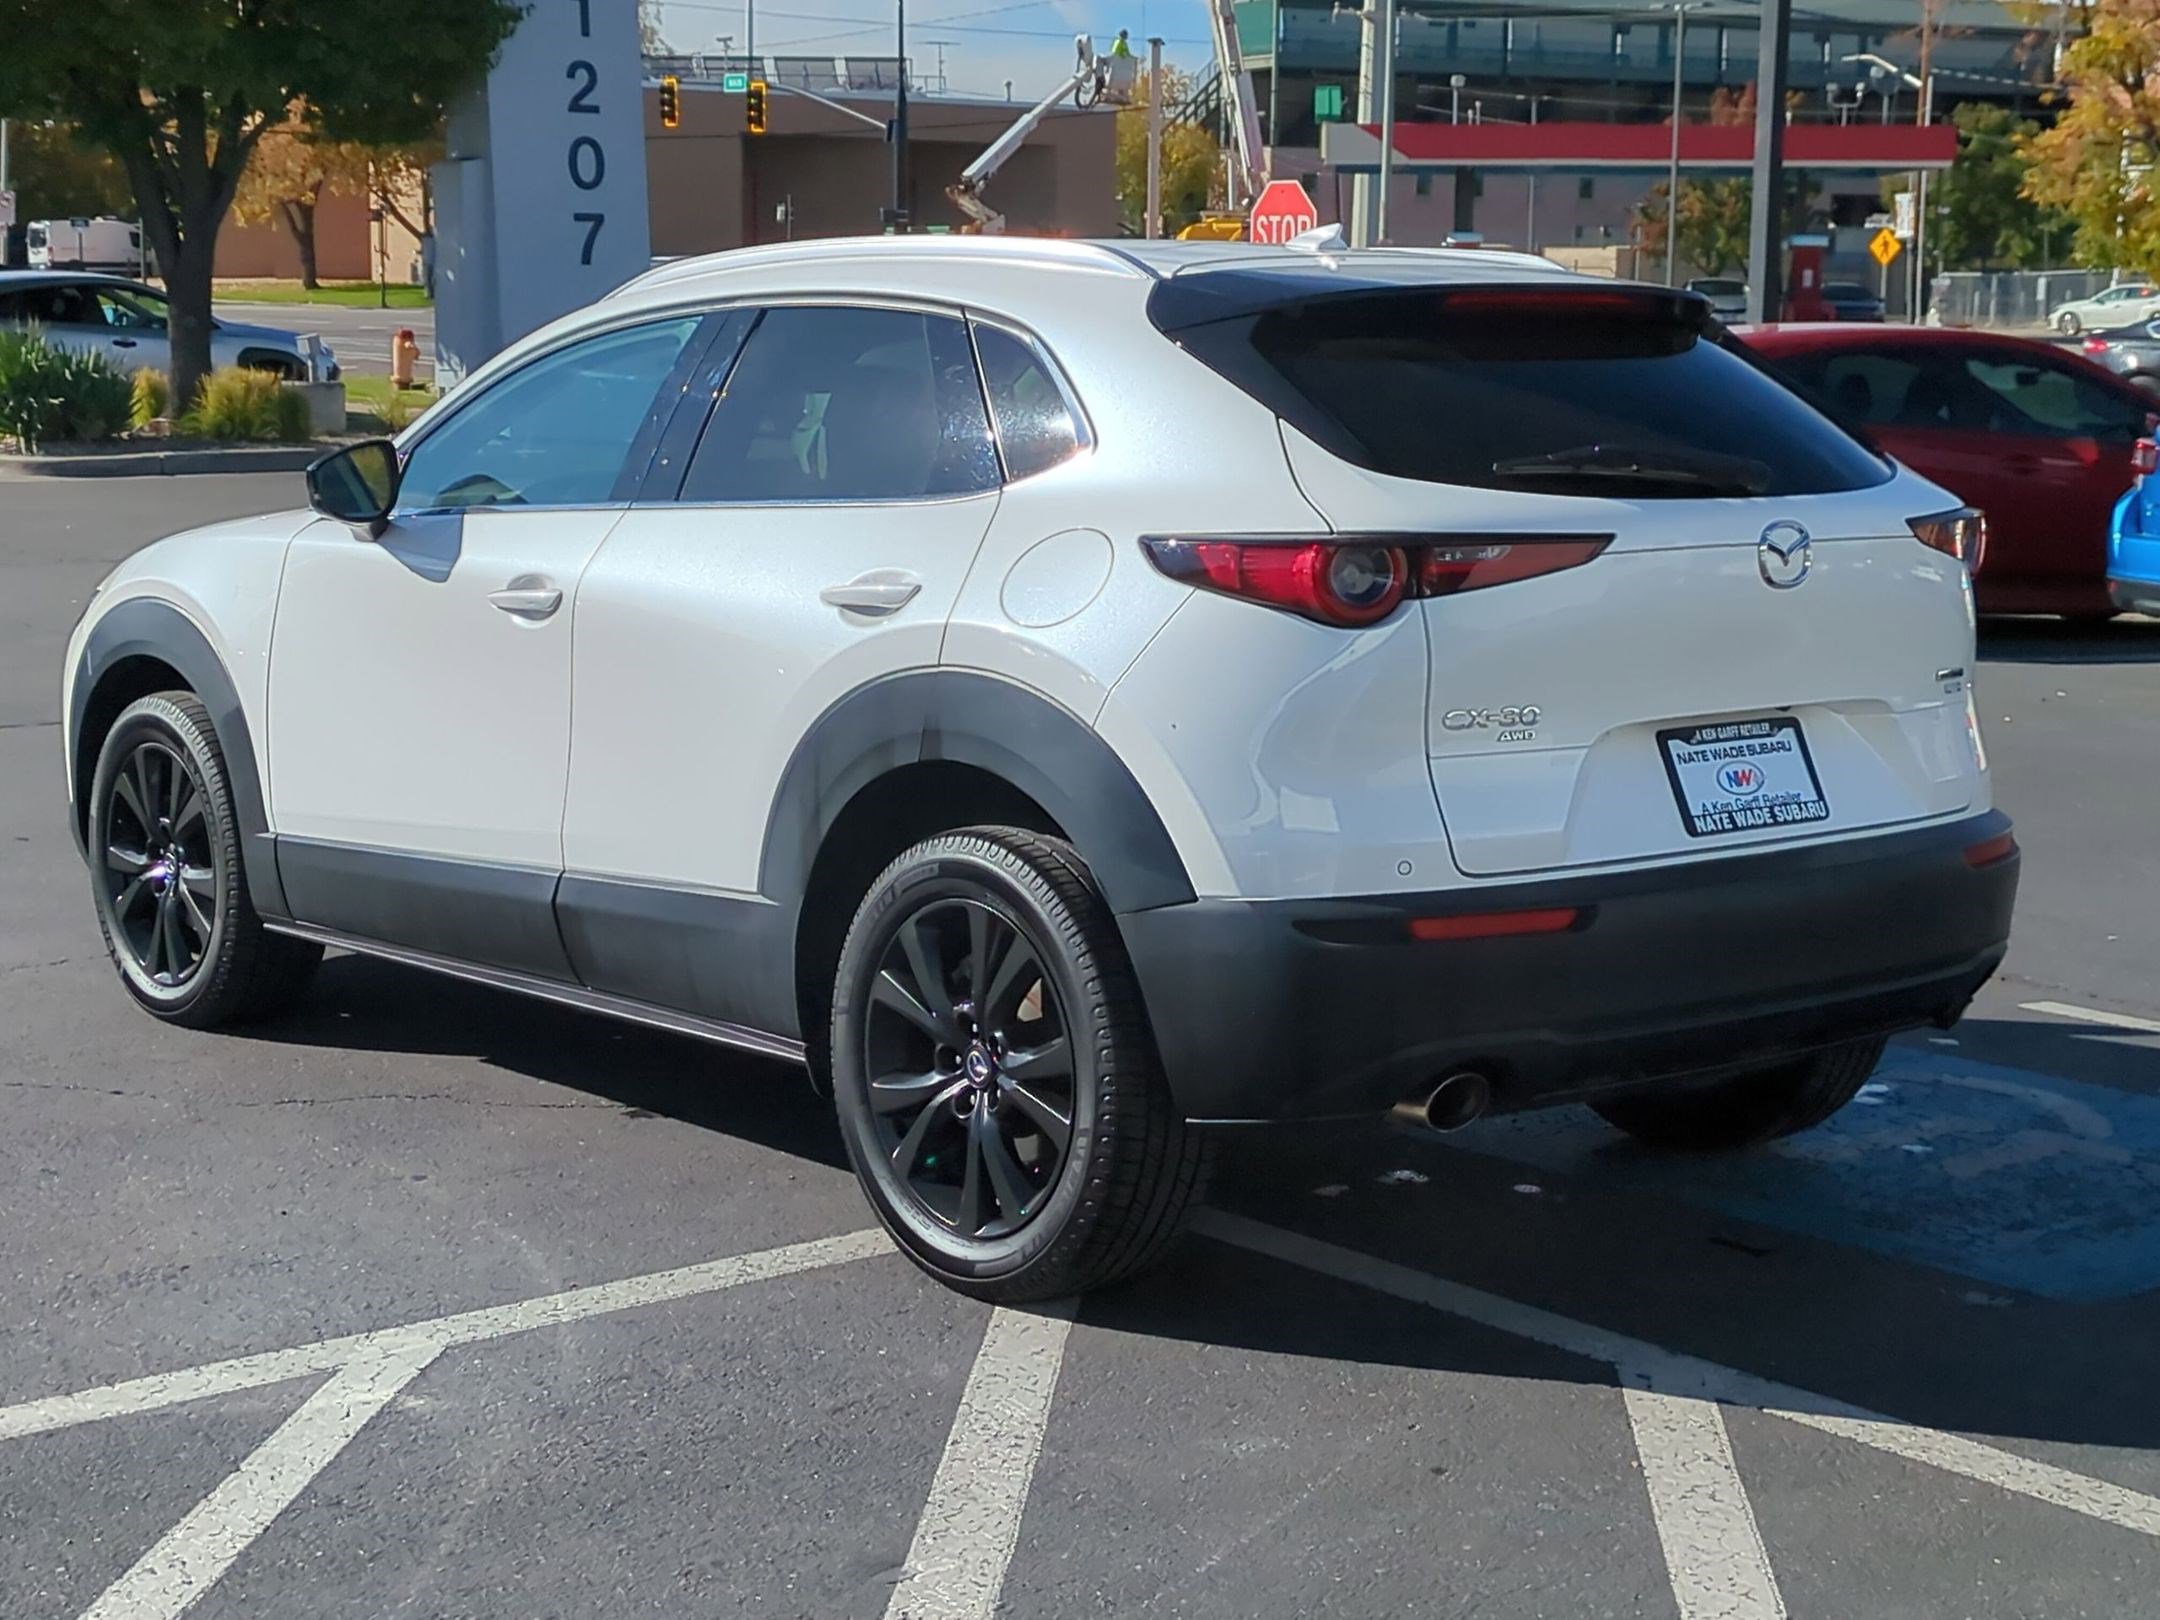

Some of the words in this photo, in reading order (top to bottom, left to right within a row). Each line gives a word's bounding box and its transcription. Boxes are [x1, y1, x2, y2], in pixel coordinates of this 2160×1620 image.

[1442, 705, 1541, 730] CX-30
[1497, 730, 1536, 742] AWD
[1676, 749, 1710, 765] NATE
[1710, 745, 1747, 760] WADE
[1746, 740, 1793, 757] SUBARU
[1701, 802, 1710, 813] A
[1711, 801, 1733, 812] Ken
[1735, 795, 1760, 810] Garff
[1761, 791, 1802, 807] Retailer
[1693, 813, 1732, 833] NATE
[1732, 807, 1775, 828] WADE
[1774, 801, 1827, 822] SUBARU
